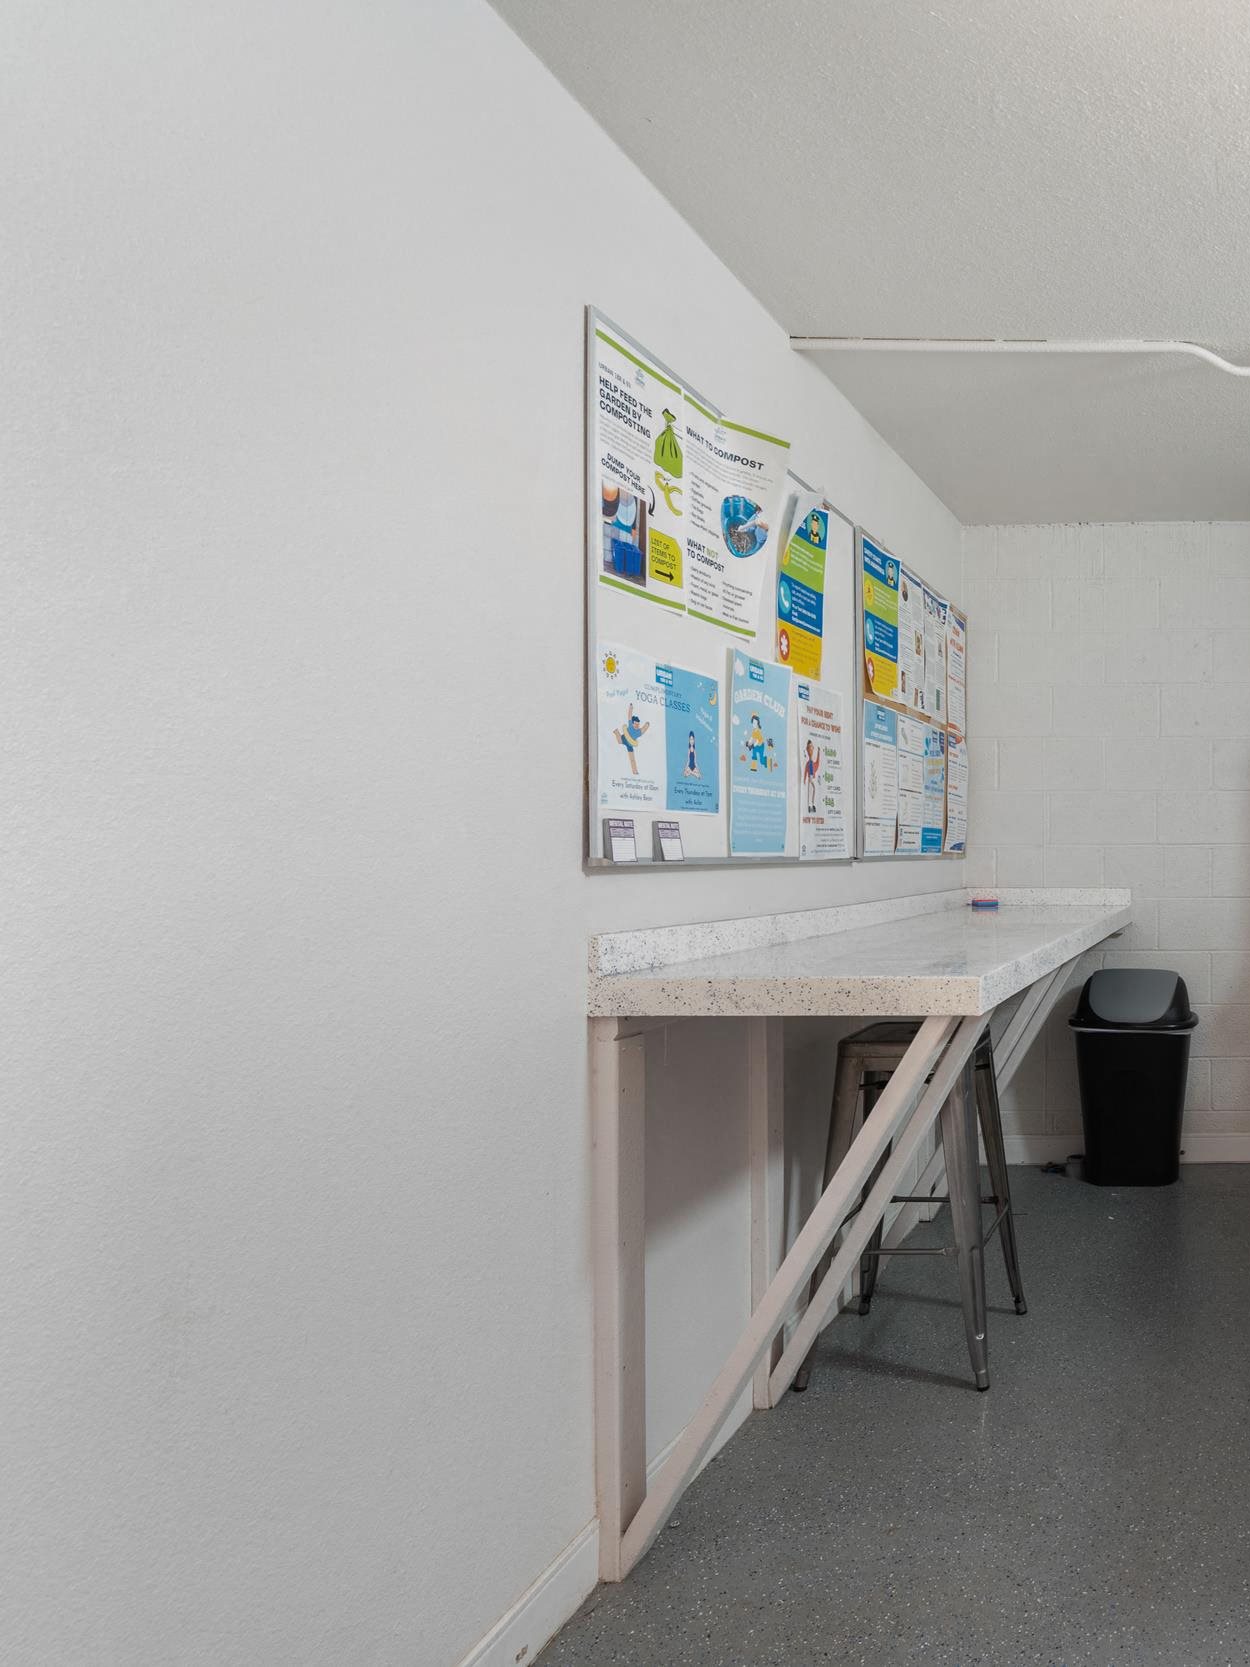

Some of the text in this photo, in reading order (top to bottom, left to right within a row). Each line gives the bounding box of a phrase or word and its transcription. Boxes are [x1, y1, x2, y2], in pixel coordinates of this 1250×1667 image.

[600, 376, 618, 393] HELP
[620, 389, 638, 407] FEED
[639, 402, 652, 418] THE
[600, 388, 641, 421] GARDEN BY
[600, 401, 651, 438] COMPOSTING
[686, 426, 764, 470] WHAT TO COMPOST
[602, 458, 646, 495] COMPOST HERE
[607, 453, 640, 482] DUMP YOUR
[651, 547, 666, 559] ITEMS
[687, 538, 718, 560] WHAT NOT
[687, 549, 724, 573] TO COMPOST
[651, 555, 676, 570] COMPOST
[635, 690, 691, 713] YOGA CLASSES
[764, 694, 785, 718] CLUB
